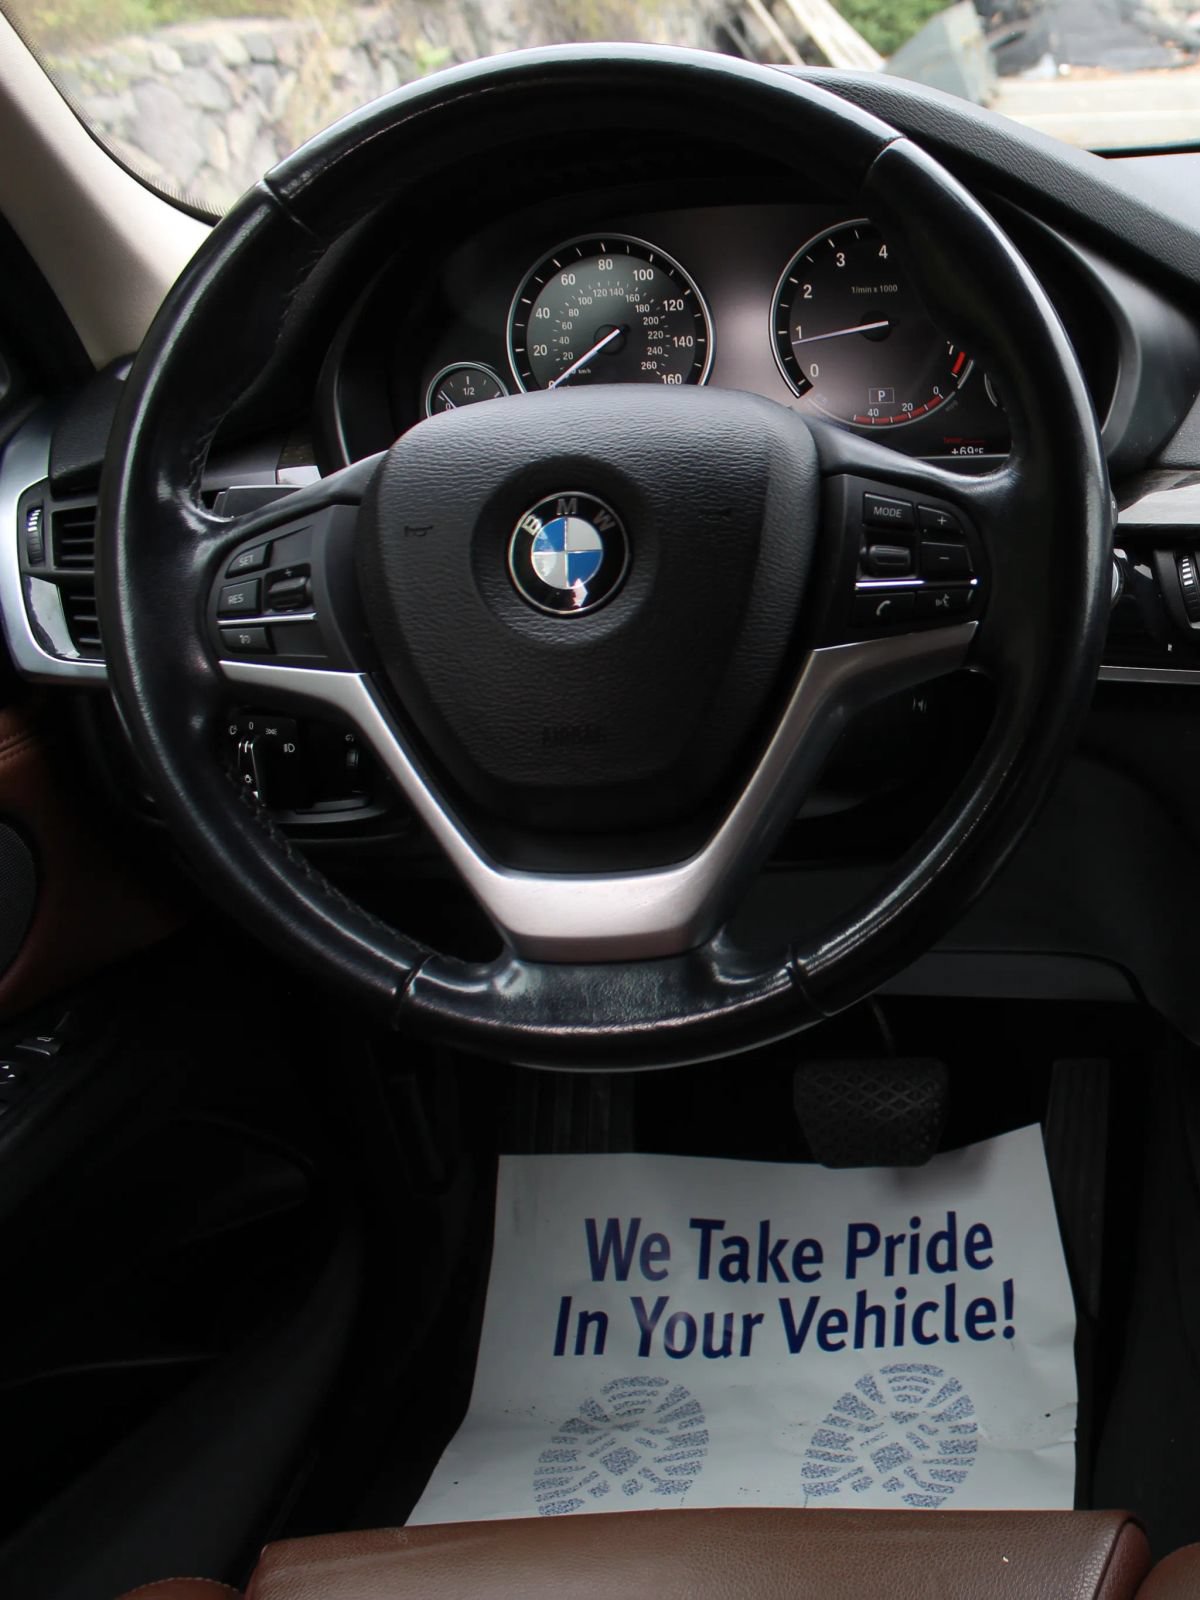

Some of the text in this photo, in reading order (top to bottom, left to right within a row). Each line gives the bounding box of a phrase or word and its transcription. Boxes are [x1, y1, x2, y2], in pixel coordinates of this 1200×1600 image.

[878, 244, 889, 260] 4
[598, 259, 613, 271] 80
[836, 252, 846, 268] 3
[561, 274, 576, 286] 60
[633, 269, 654, 281] 100
[593, 288, 608, 298] 120
[609, 288, 624, 297] 140
[803, 284, 813, 299] 2
[879, 284, 898, 293] 1000
[578, 296, 592, 306] 100
[625, 293, 640, 303] 160
[635, 304, 650, 313] 180
[663, 299, 684, 312] 120
[536, 307, 550, 320] 40
[568, 308, 579, 317] 80
[562, 321, 573, 331] 60
[643, 316, 659, 325] 200
[647, 330, 664, 340] 220
[795, 325, 803, 340] 1
[559, 336, 570, 345] 40
[672, 336, 694, 348] 140
[533, 344, 548, 356] 20
[647, 346, 663, 356] 240
[562, 351, 574, 361] 20
[641, 361, 657, 370] 260
[810, 363, 819, 378] 0
[661, 373, 683, 385] 160
[463, 387, 475, 396] 1/2
[933, 386, 939, 395] 0
[867, 408, 879, 418] 40
[902, 403, 914, 412] 20
[522, 498, 616, 536] BMW
[873, 506, 903, 519] MODE
[227, 593, 244, 605] RES
[584, 1210, 994, 1284] We Take Pride
[553, 1278, 1016, 1360] In Your Vehicle!
